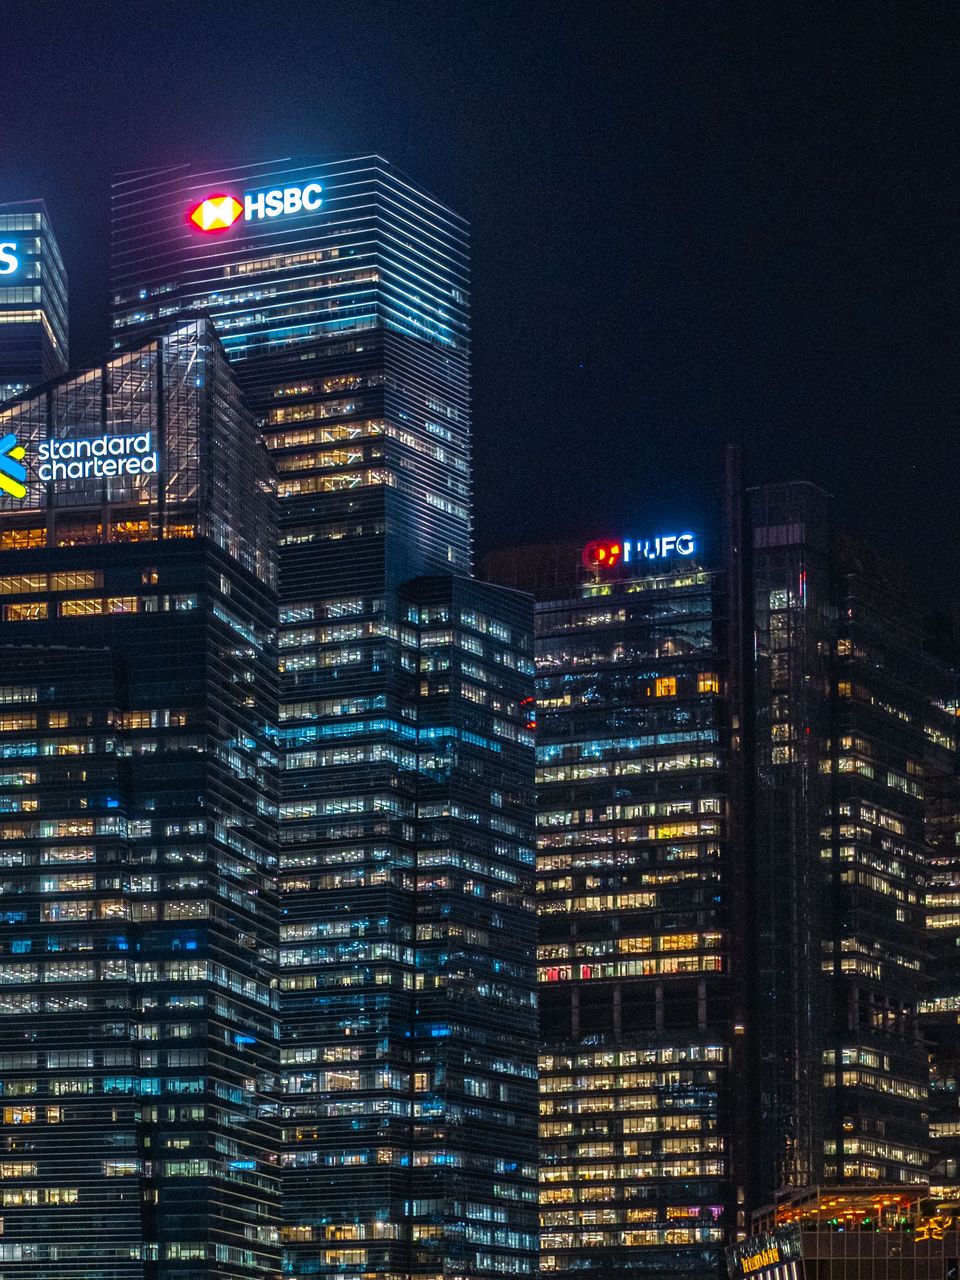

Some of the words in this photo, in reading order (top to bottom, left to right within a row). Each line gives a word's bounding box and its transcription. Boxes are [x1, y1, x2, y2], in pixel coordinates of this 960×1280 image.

[244, 183, 323, 221] HSBC
[38, 431, 151, 461] standard
[39, 452, 158, 481] chartered
